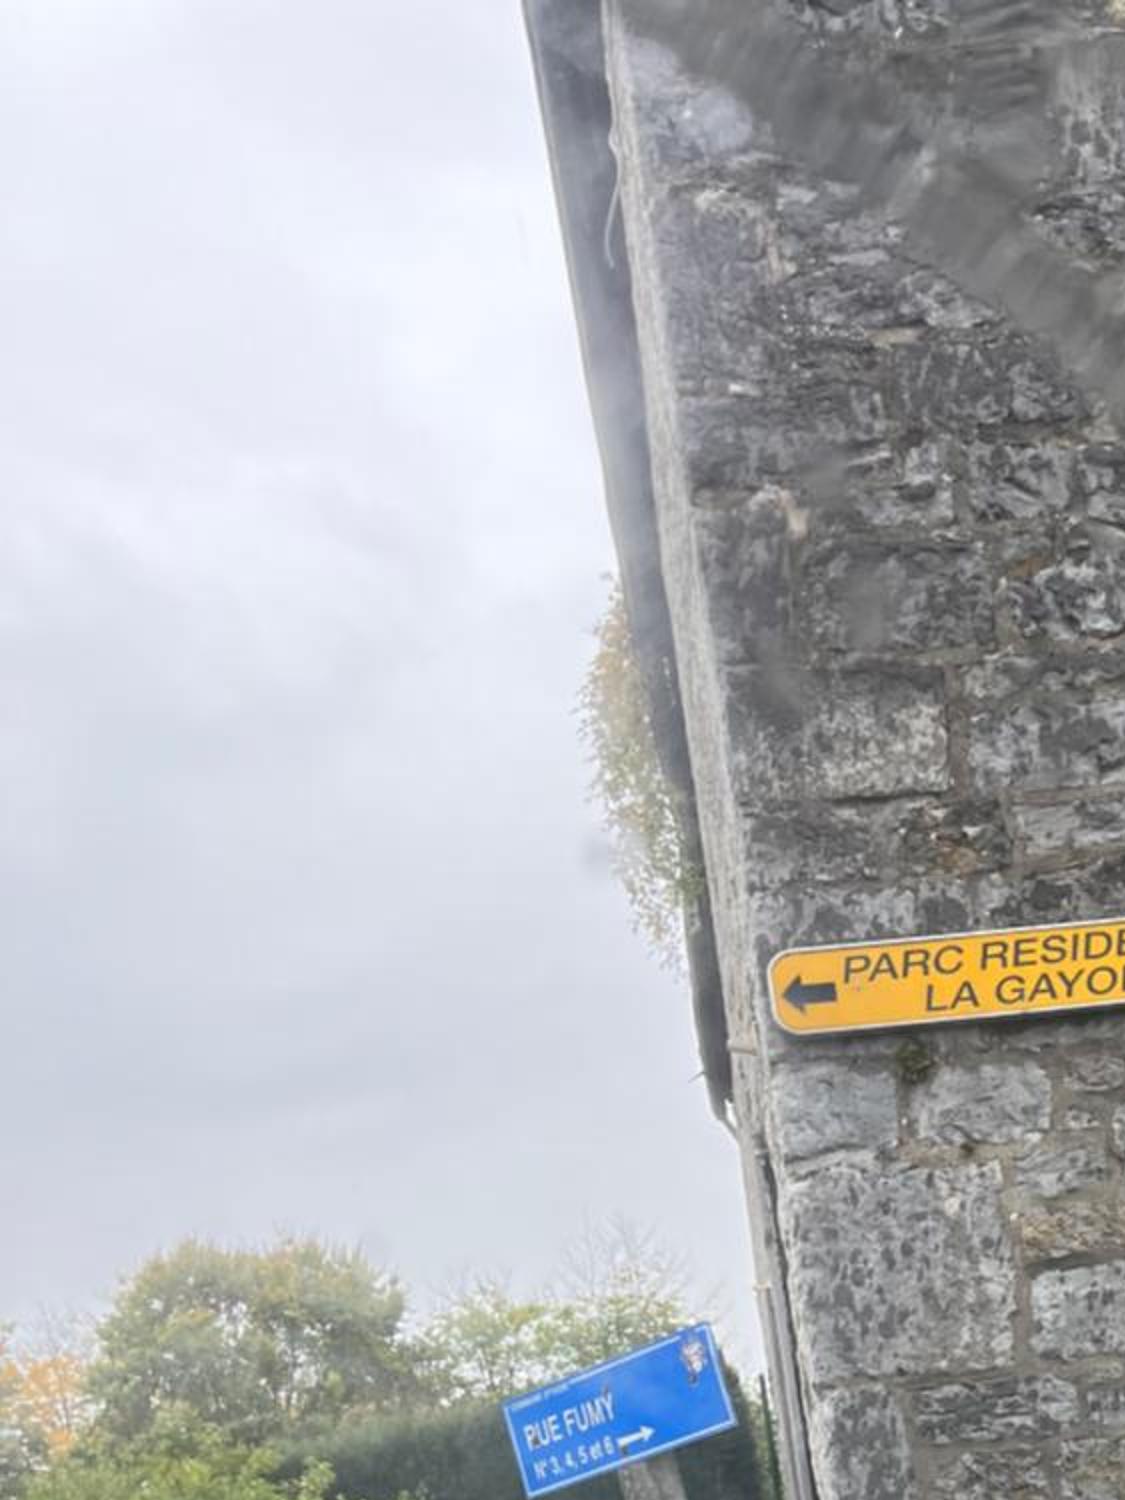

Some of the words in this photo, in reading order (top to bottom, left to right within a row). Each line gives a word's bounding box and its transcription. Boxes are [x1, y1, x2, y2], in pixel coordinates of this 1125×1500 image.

[843, 945, 963, 984] PARC
[926, 980, 980, 1012] LA
[563, 1392, 614, 1437] FUMY
